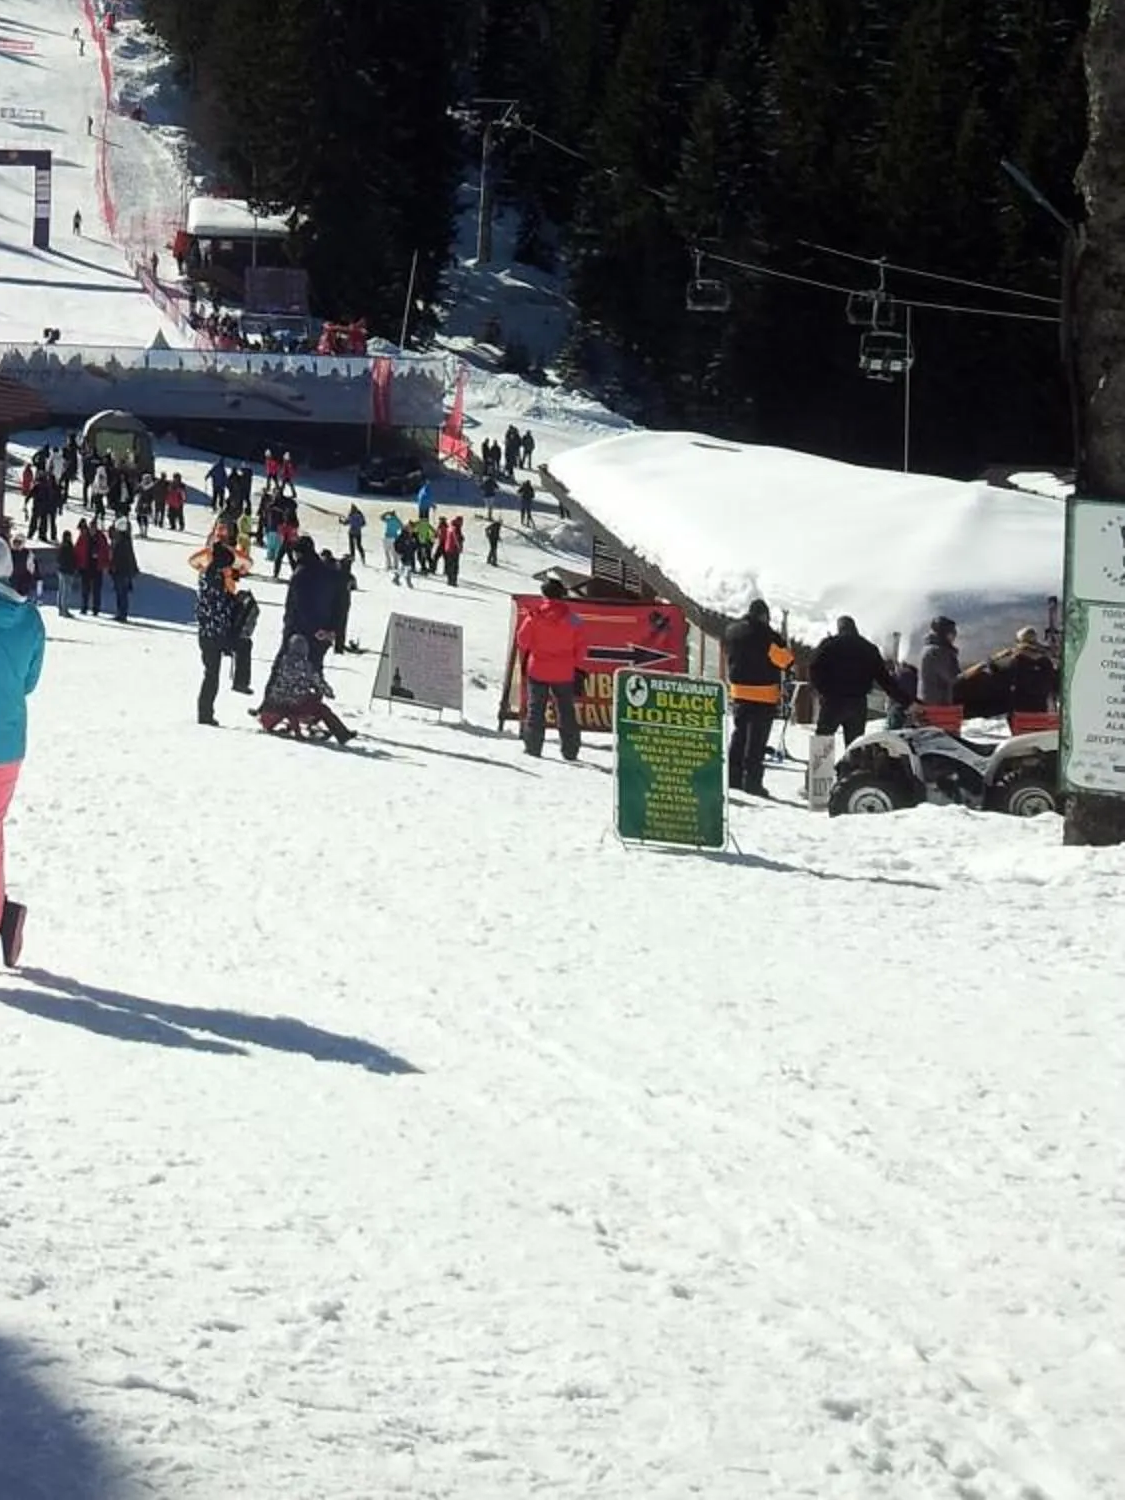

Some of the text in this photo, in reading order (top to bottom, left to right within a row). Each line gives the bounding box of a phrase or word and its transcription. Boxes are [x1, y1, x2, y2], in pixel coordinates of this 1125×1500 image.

[650, 678, 718, 696] RESTAURANT
[656, 691, 716, 712] BLACK
[626, 706, 717, 728] HORSE
